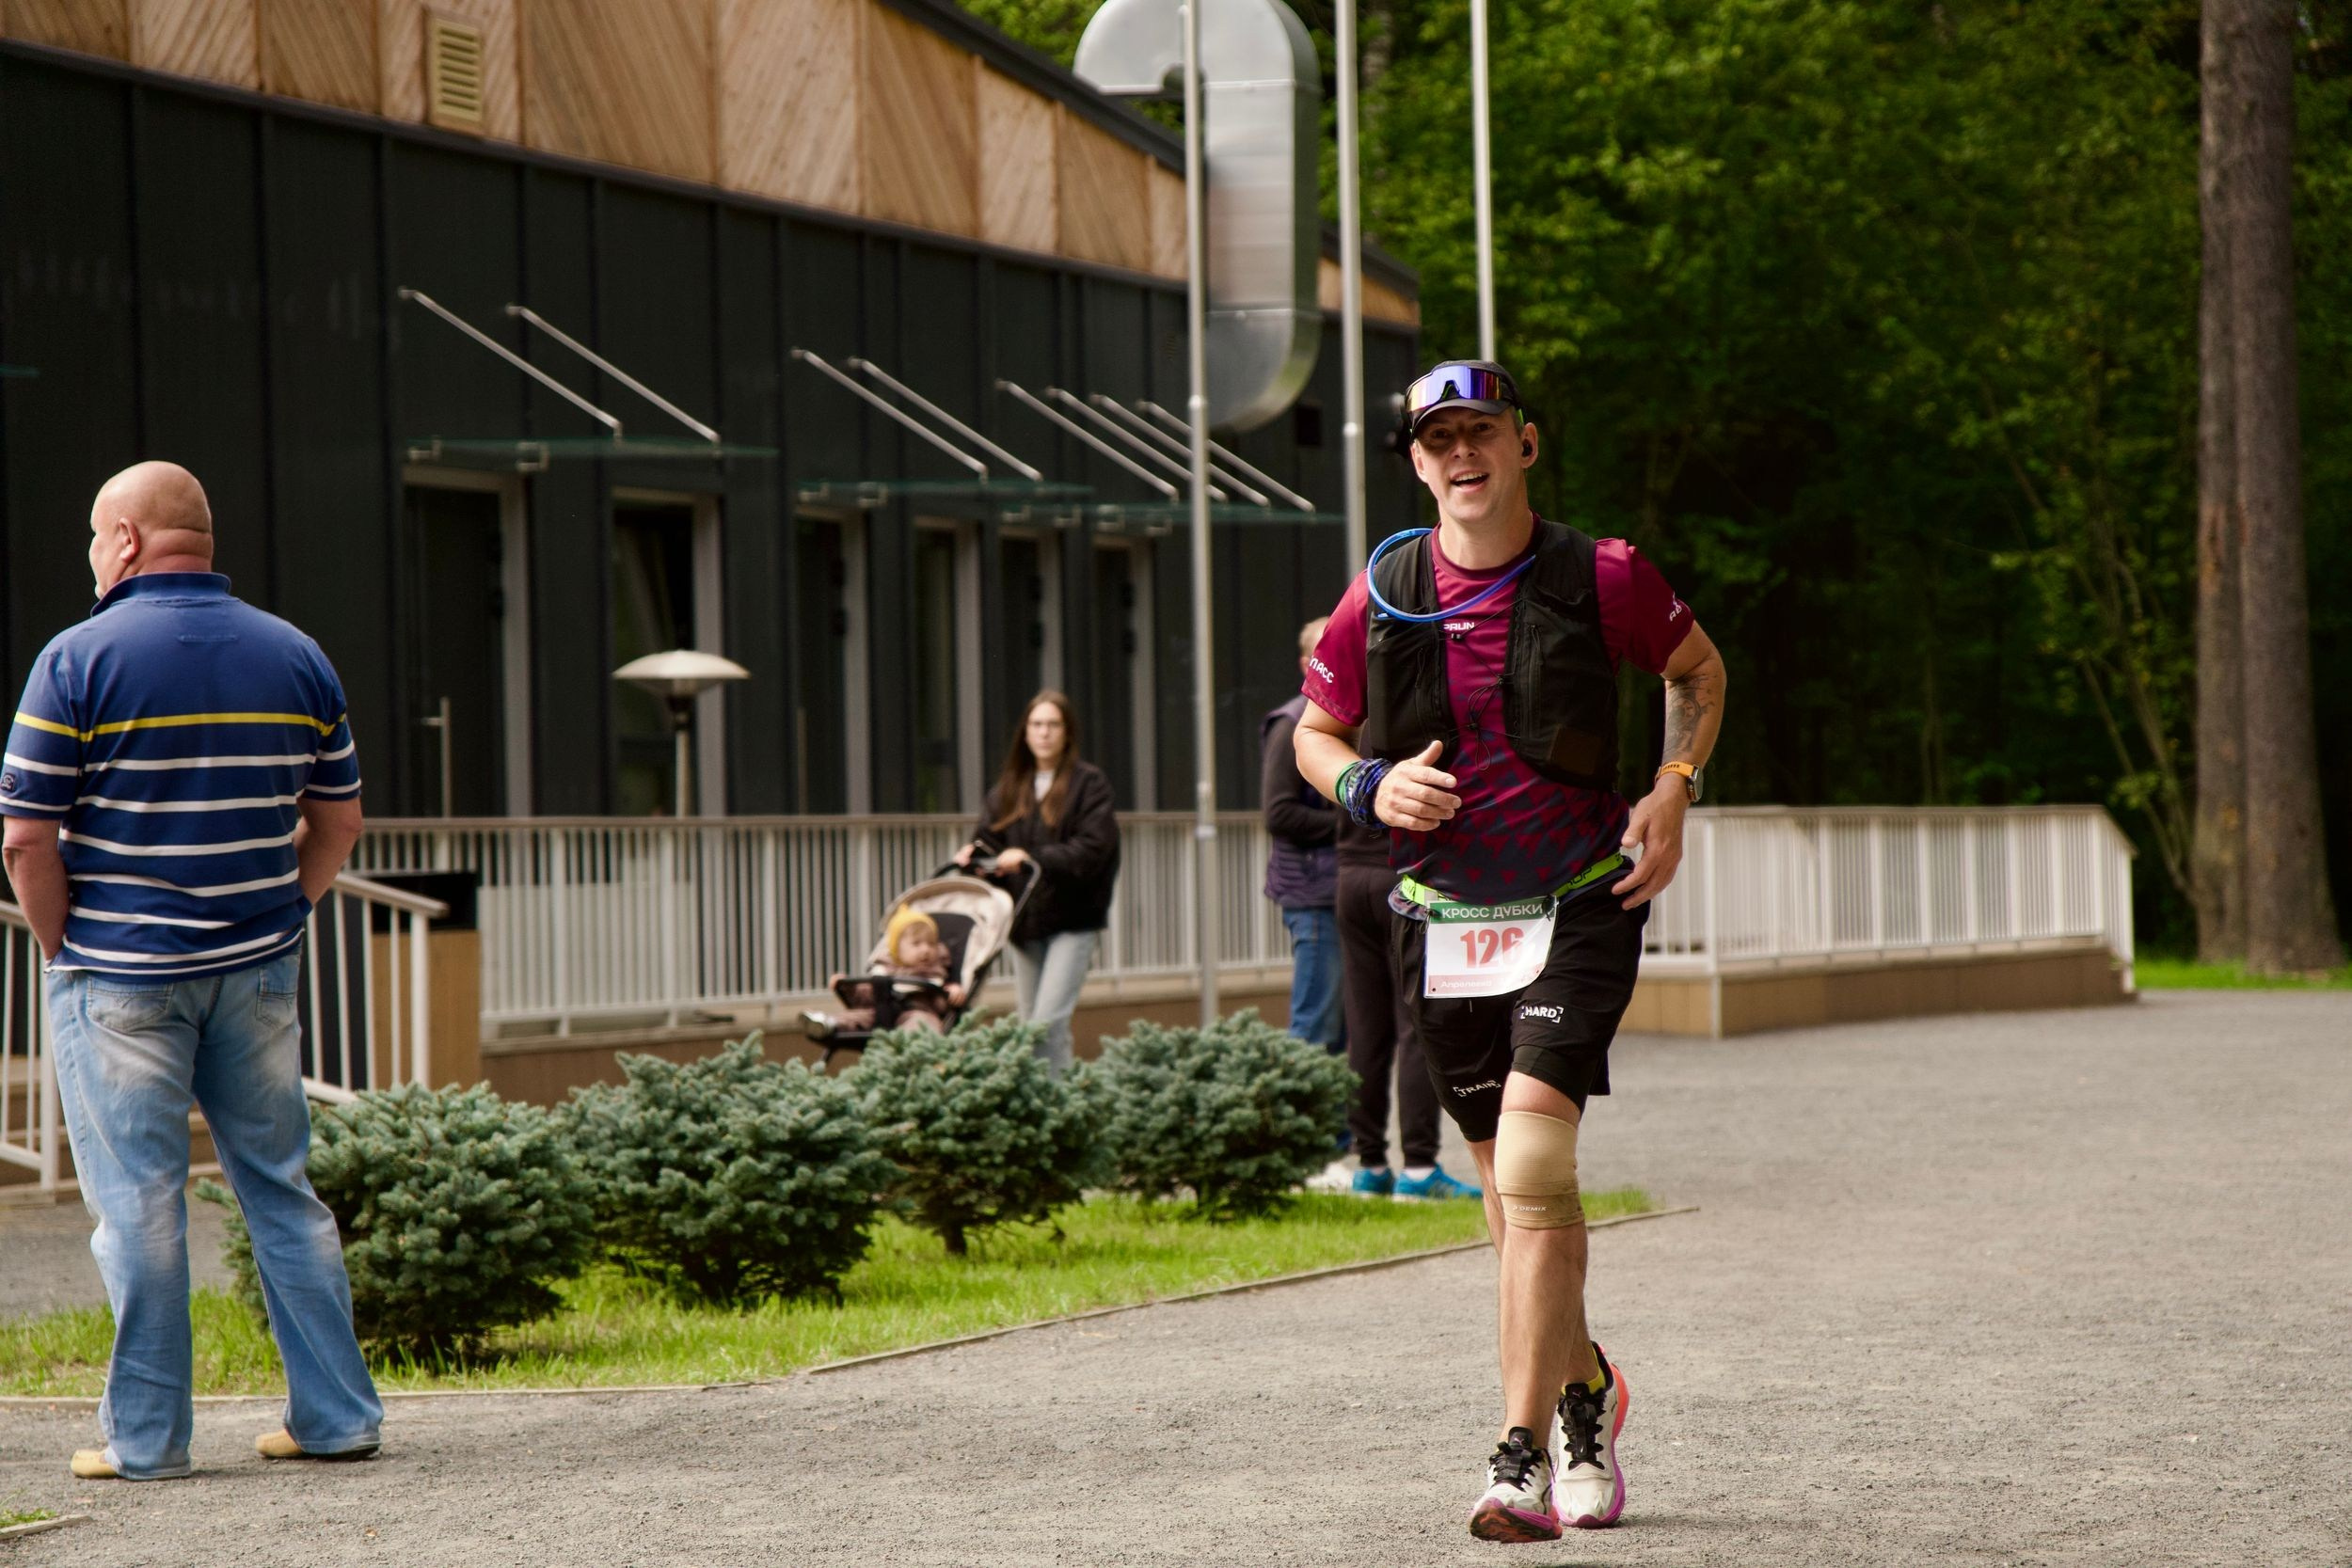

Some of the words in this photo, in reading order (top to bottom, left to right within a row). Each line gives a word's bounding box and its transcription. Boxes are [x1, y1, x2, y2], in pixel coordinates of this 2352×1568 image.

[1441, 907, 1489, 919] КРОСС
[1492, 905, 1543, 919] ДУБКИ
[1459, 927, 1524, 969] 126
